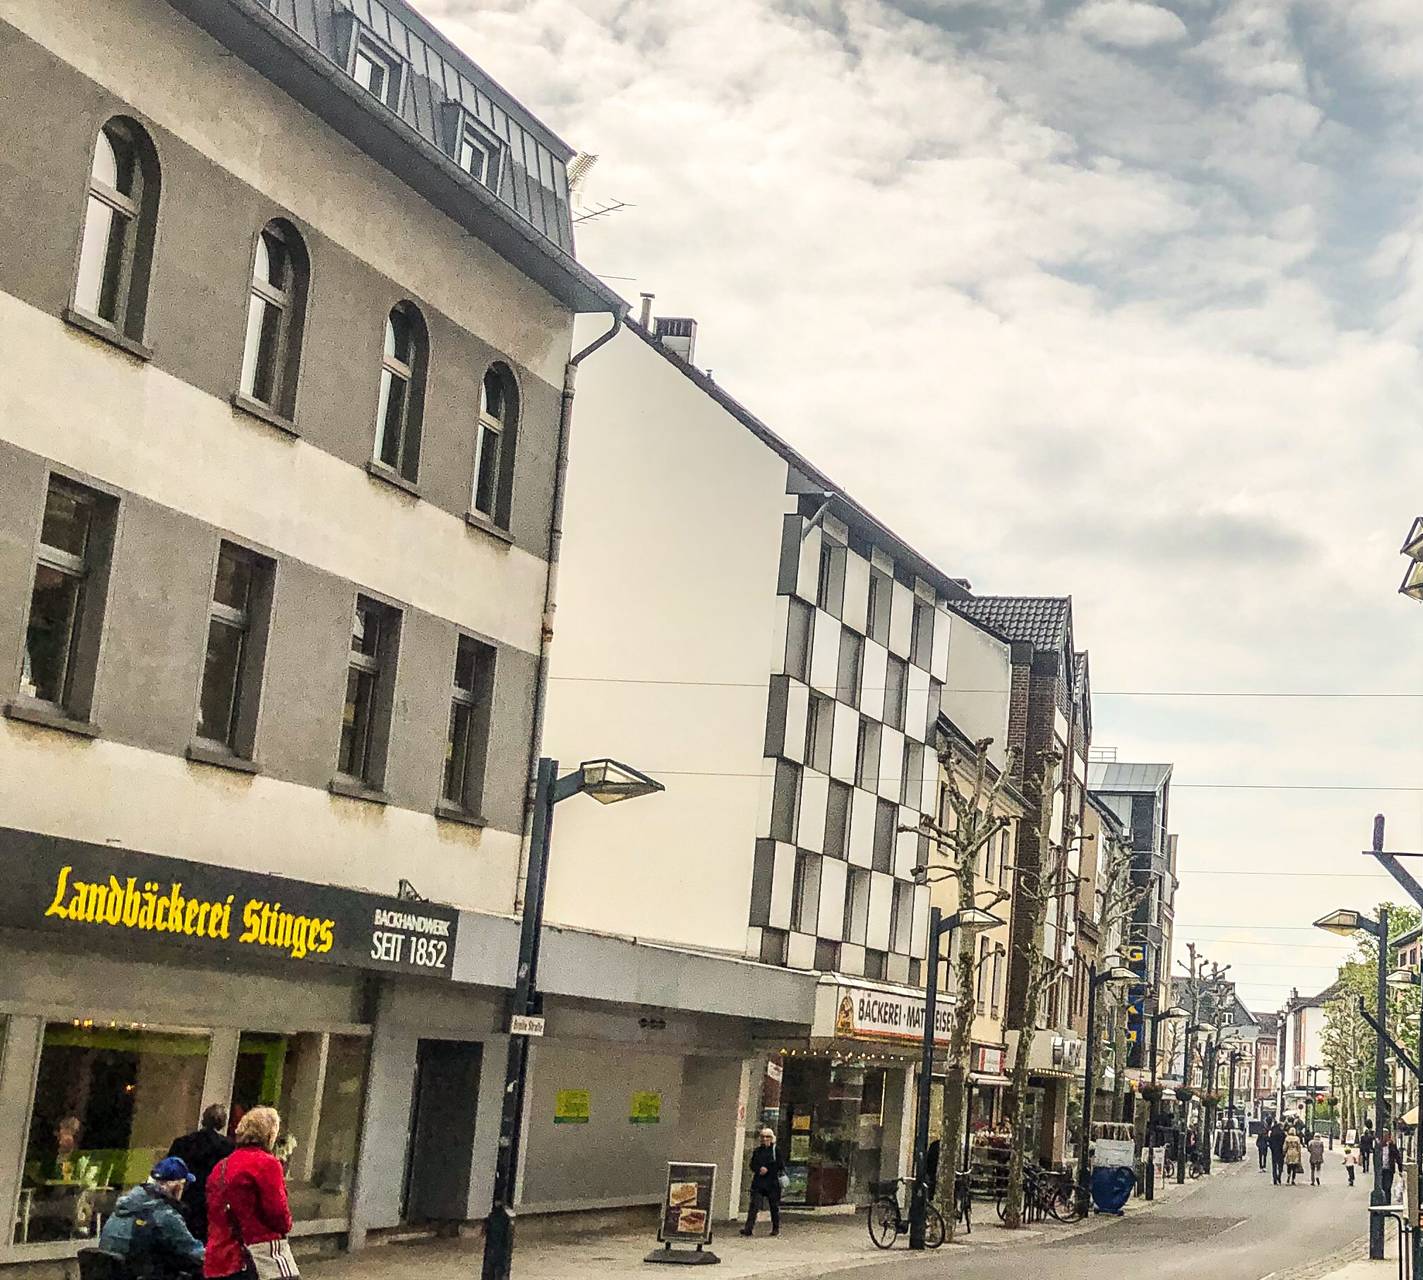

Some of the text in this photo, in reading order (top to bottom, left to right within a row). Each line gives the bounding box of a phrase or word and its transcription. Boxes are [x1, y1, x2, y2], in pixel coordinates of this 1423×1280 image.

[45, 866, 335, 958] Landbäckerei Stinges
[374, 908, 450, 937] BACKHANDWERK
[370, 931, 447, 968] SEIT 1852
[858, 992, 902, 1027] BÄCKEREI
